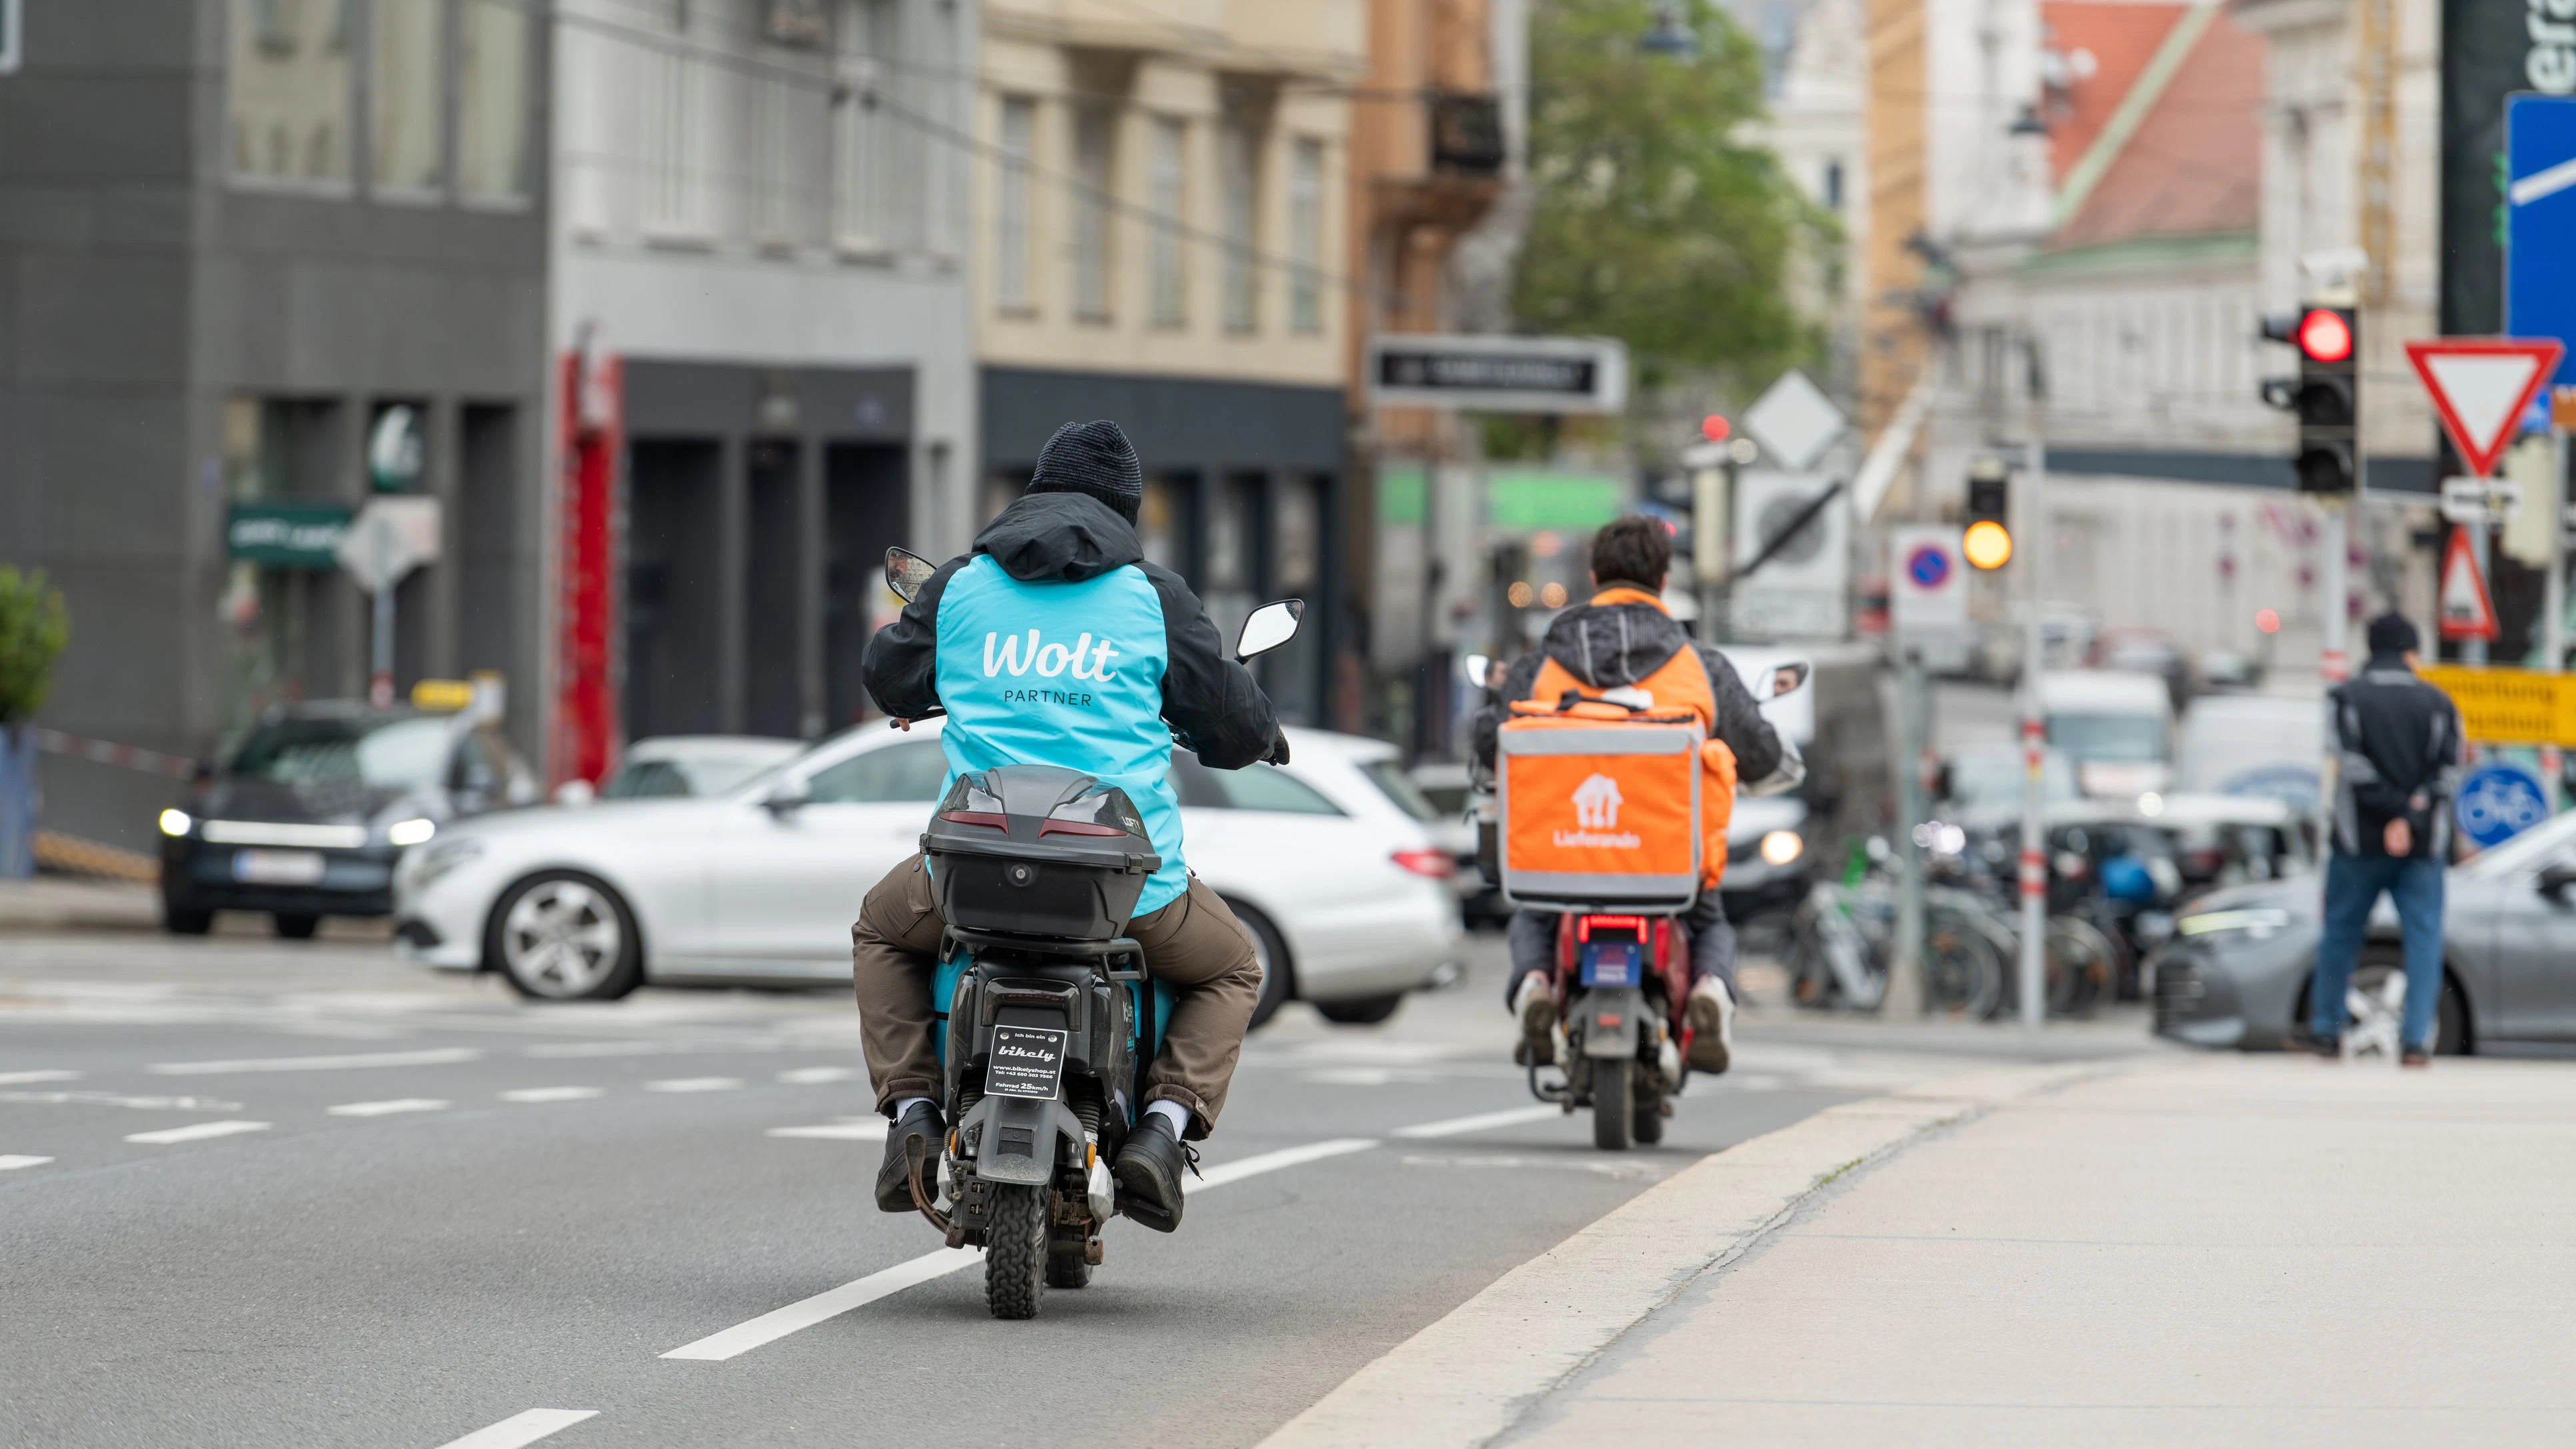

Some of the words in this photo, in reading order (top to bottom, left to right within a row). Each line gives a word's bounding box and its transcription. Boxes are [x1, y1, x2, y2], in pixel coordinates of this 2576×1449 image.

[983, 629, 1119, 681] Wolt
[1004, 690, 1092, 707] PARTNER
[1121, 816, 1141, 830] LOFTY
[1553, 828, 1641, 849] Lieferando
[998, 1046, 1056, 1062] bikely
[993, 1065, 1056, 1075] www.bikelyshop.at
